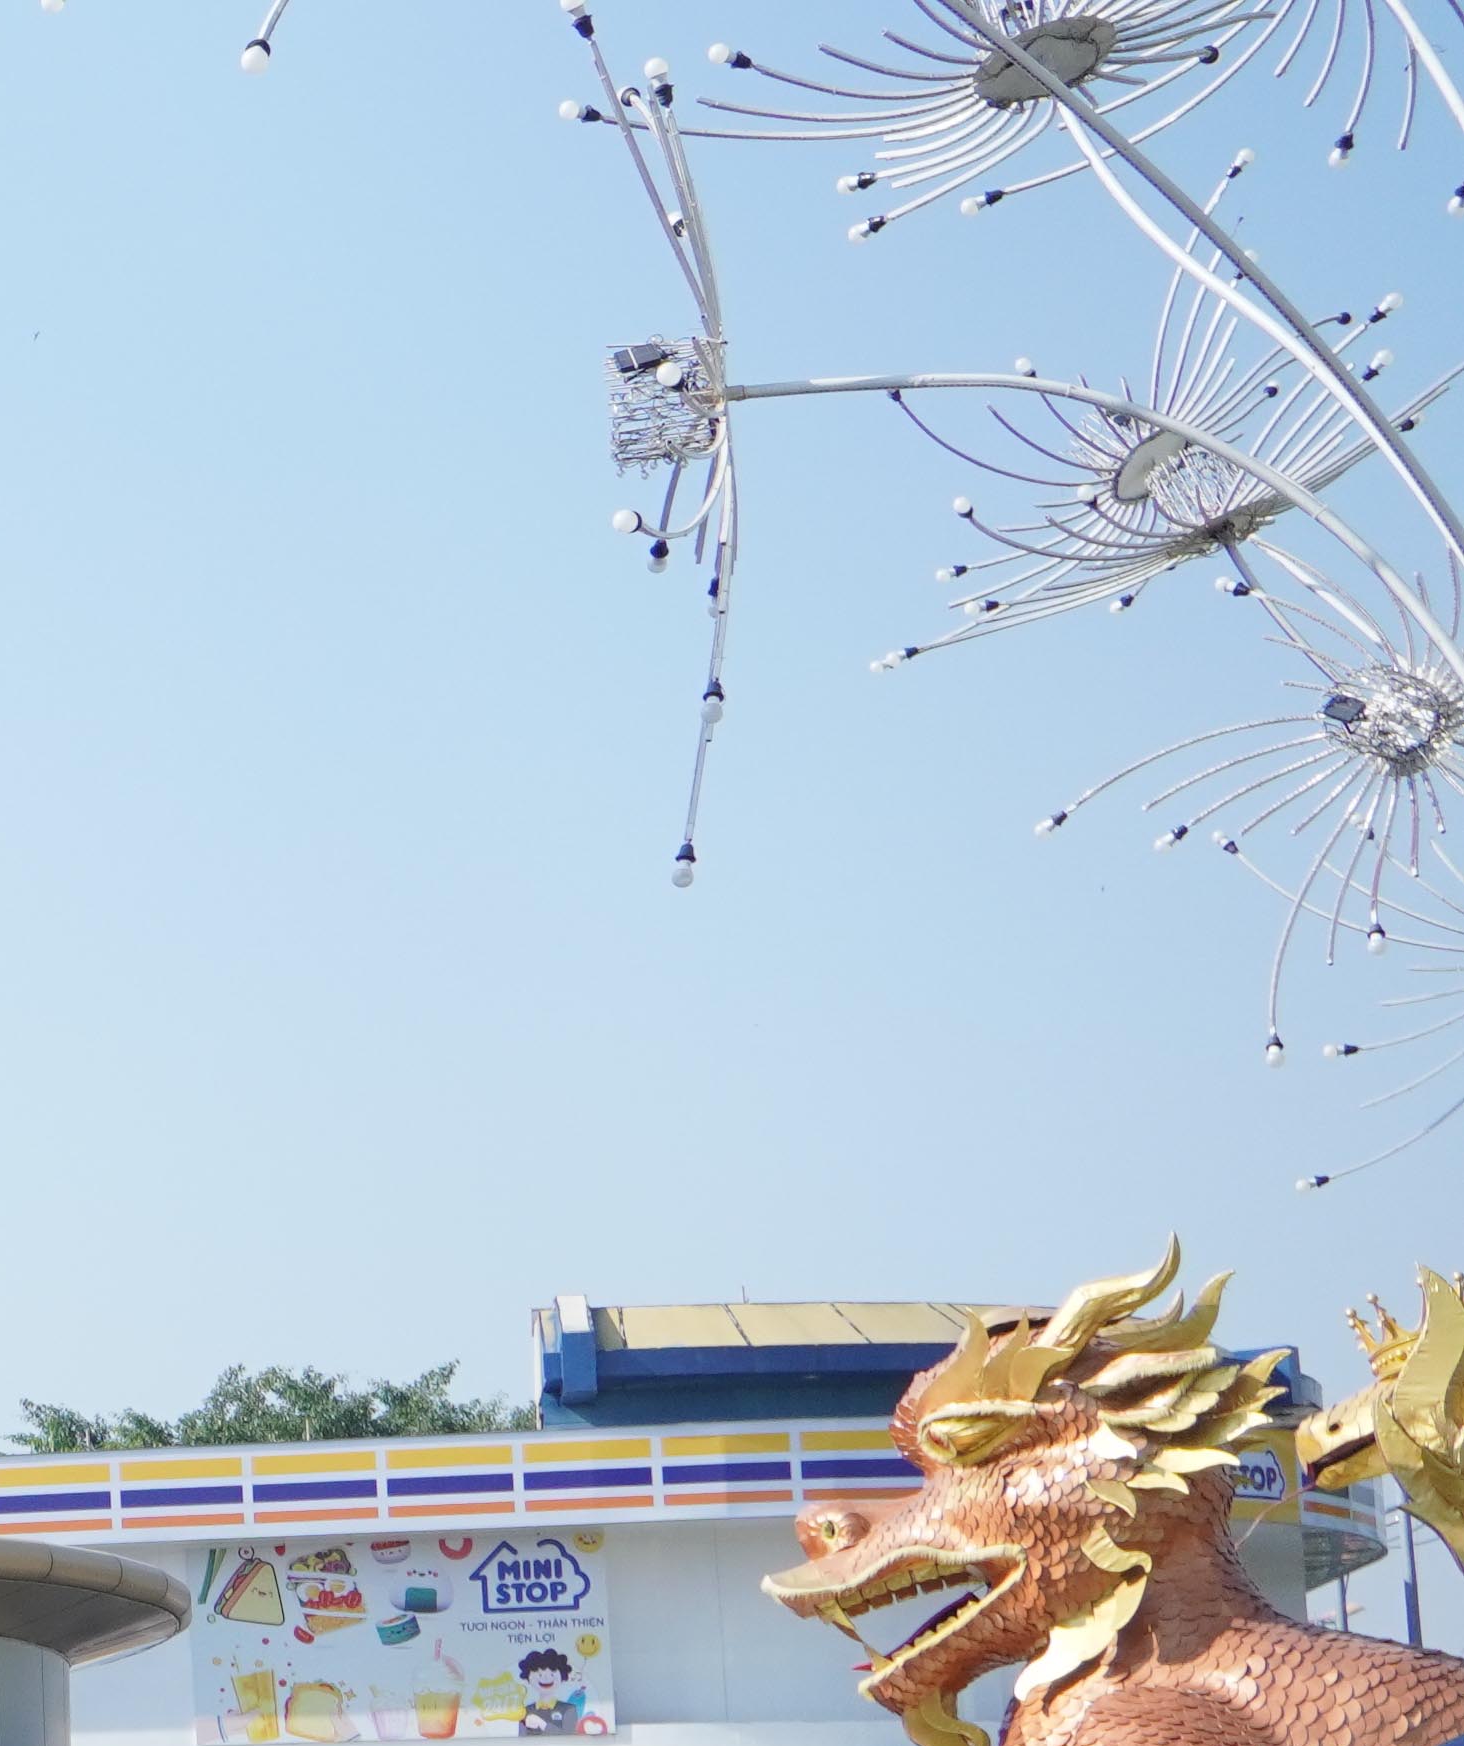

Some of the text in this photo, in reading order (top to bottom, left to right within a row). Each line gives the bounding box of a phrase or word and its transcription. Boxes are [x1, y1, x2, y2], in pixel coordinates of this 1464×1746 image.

[1232, 1465, 1277, 1492] TOP
[497, 1558, 563, 1581] MINI
[496, 1582, 568, 1605] STOP
